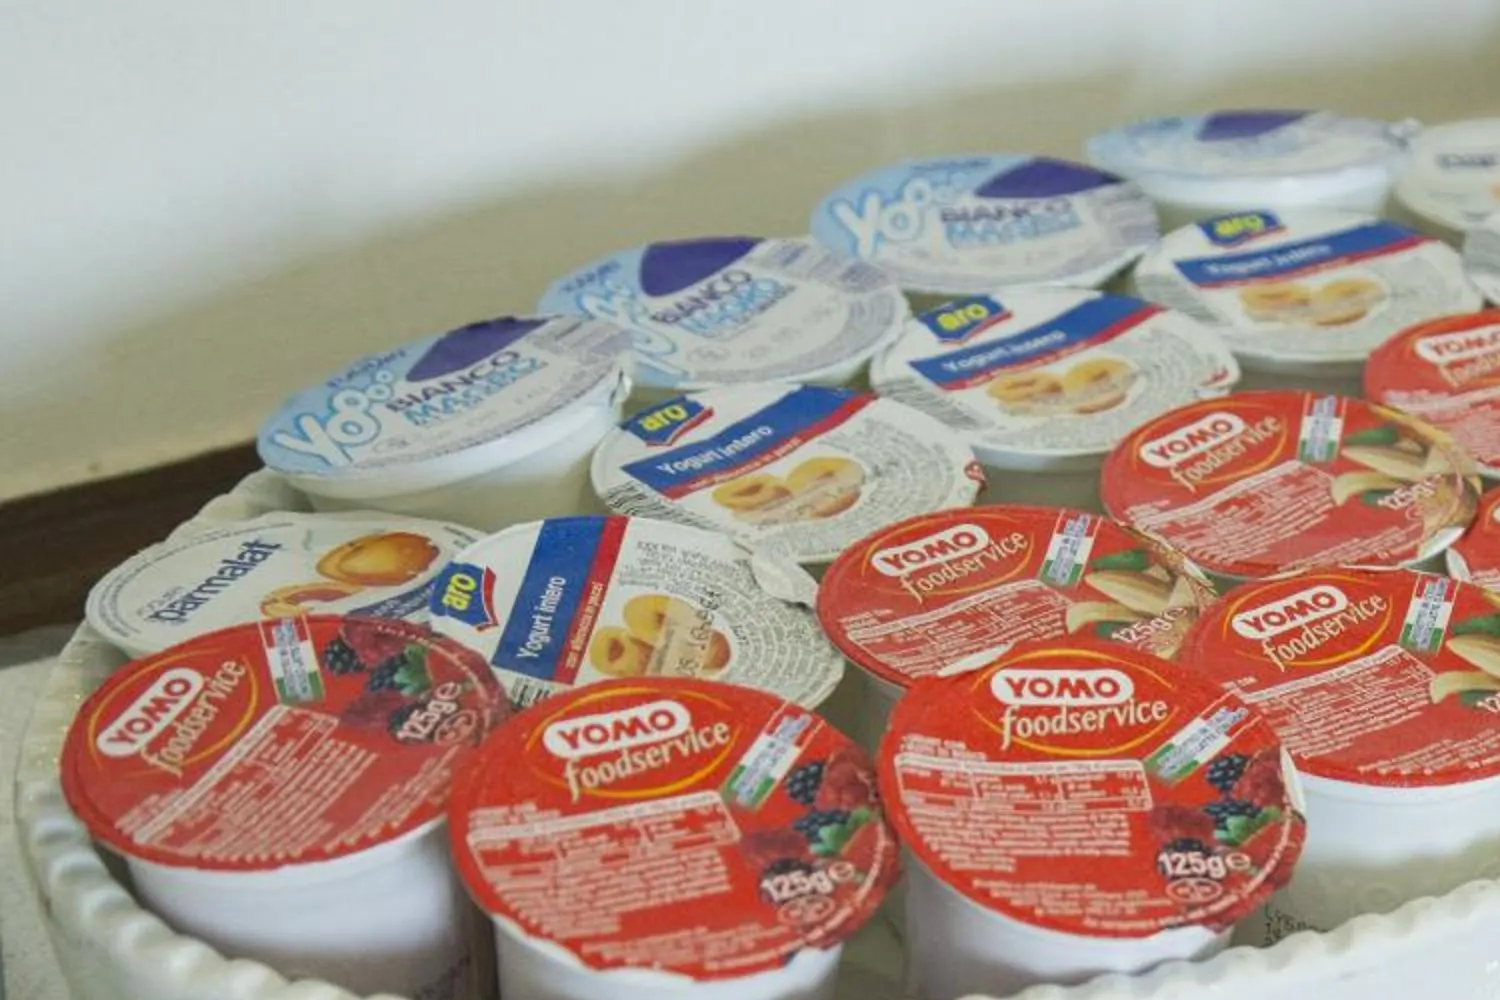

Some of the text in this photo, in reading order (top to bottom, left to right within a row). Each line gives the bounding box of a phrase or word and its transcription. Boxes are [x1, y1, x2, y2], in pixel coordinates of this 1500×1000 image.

[639, 404, 688, 432] aro
[1148, 417, 1235, 461] YOMO
[1169, 414, 1281, 493] foodservice
[148, 536, 282, 623] parmalat
[879, 531, 980, 572] YOMO
[900, 531, 1029, 604] foodservice
[441, 572, 477, 611] aro
[515, 576, 567, 659] Yogurt intero
[1238, 590, 1339, 635] YOMO
[1261, 592, 1388, 672] foodservice
[105, 677, 192, 748] YOMO
[1003, 675, 1121, 698] YOMO
[140, 659, 246, 777] foodservice
[557, 709, 678, 750] YOMO
[1000, 698, 1169, 751] foodservice
[562, 720, 731, 802] foodservice
